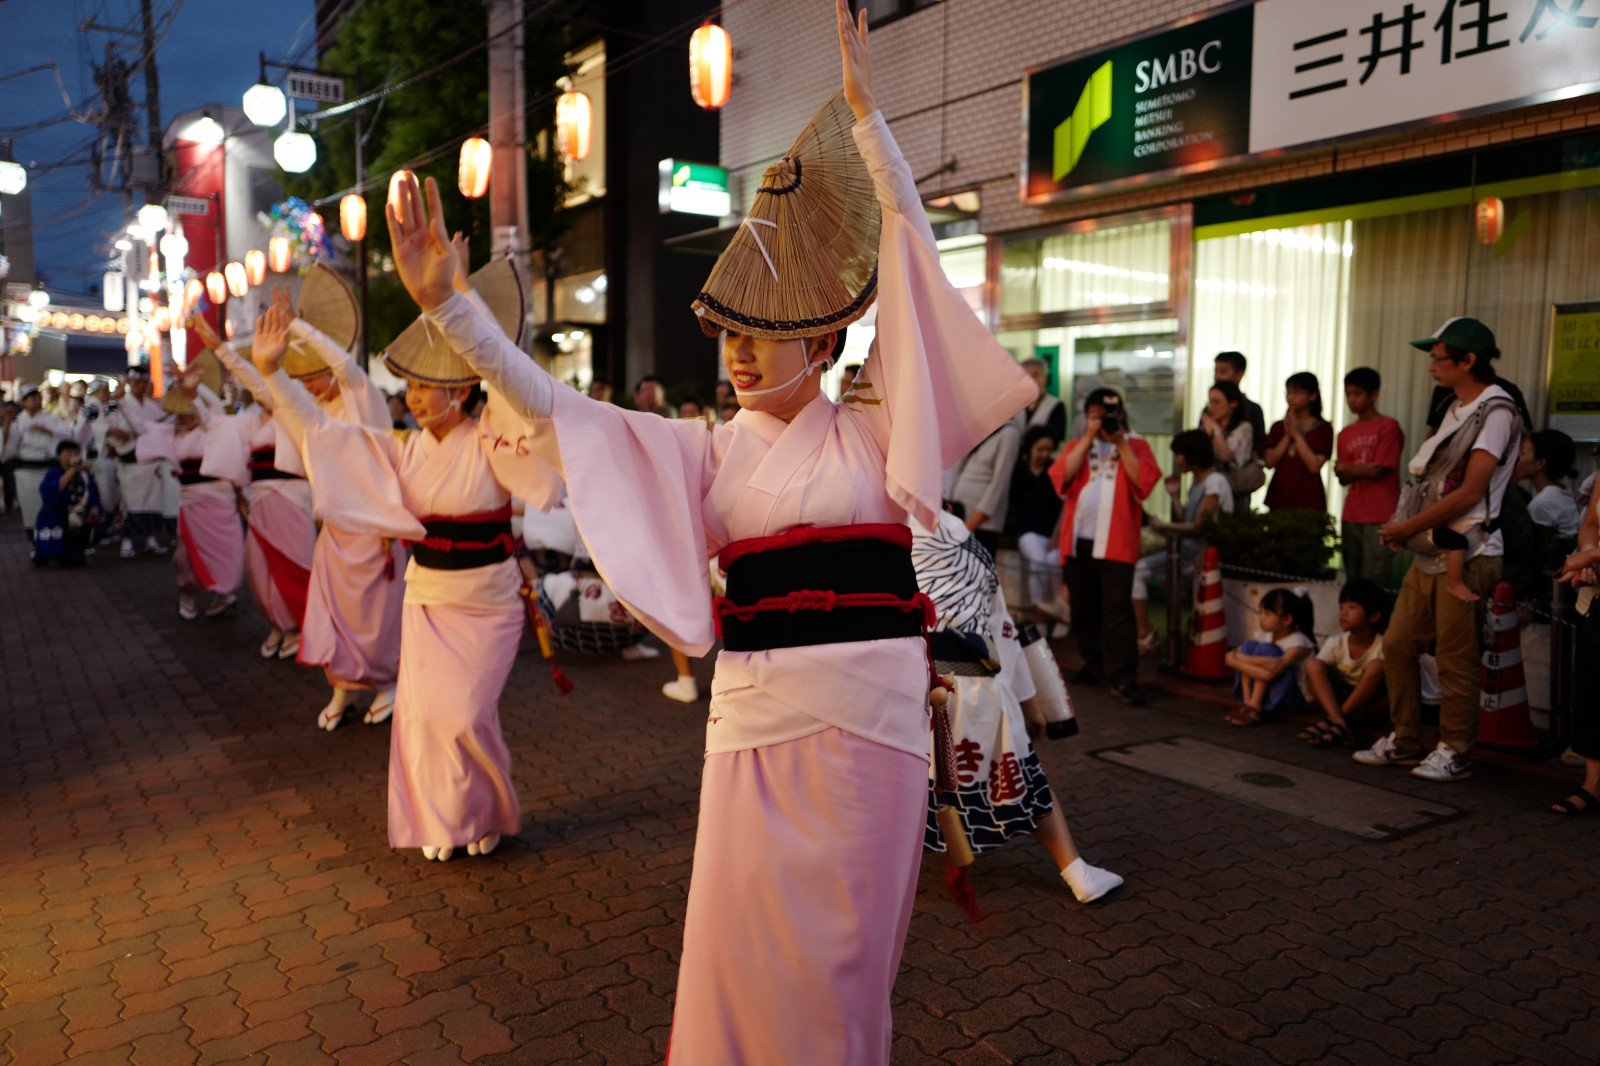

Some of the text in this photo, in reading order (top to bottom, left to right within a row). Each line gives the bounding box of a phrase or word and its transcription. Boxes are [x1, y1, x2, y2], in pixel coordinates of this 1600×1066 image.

[1134, 40, 1222, 94] SMBC
[1135, 88, 1196, 114] SUMITOMO
[1135, 108, 1173, 128] MITSUI
[1133, 130, 1214, 157] CORPORATION
[1134, 121, 1184, 143] BANKING
